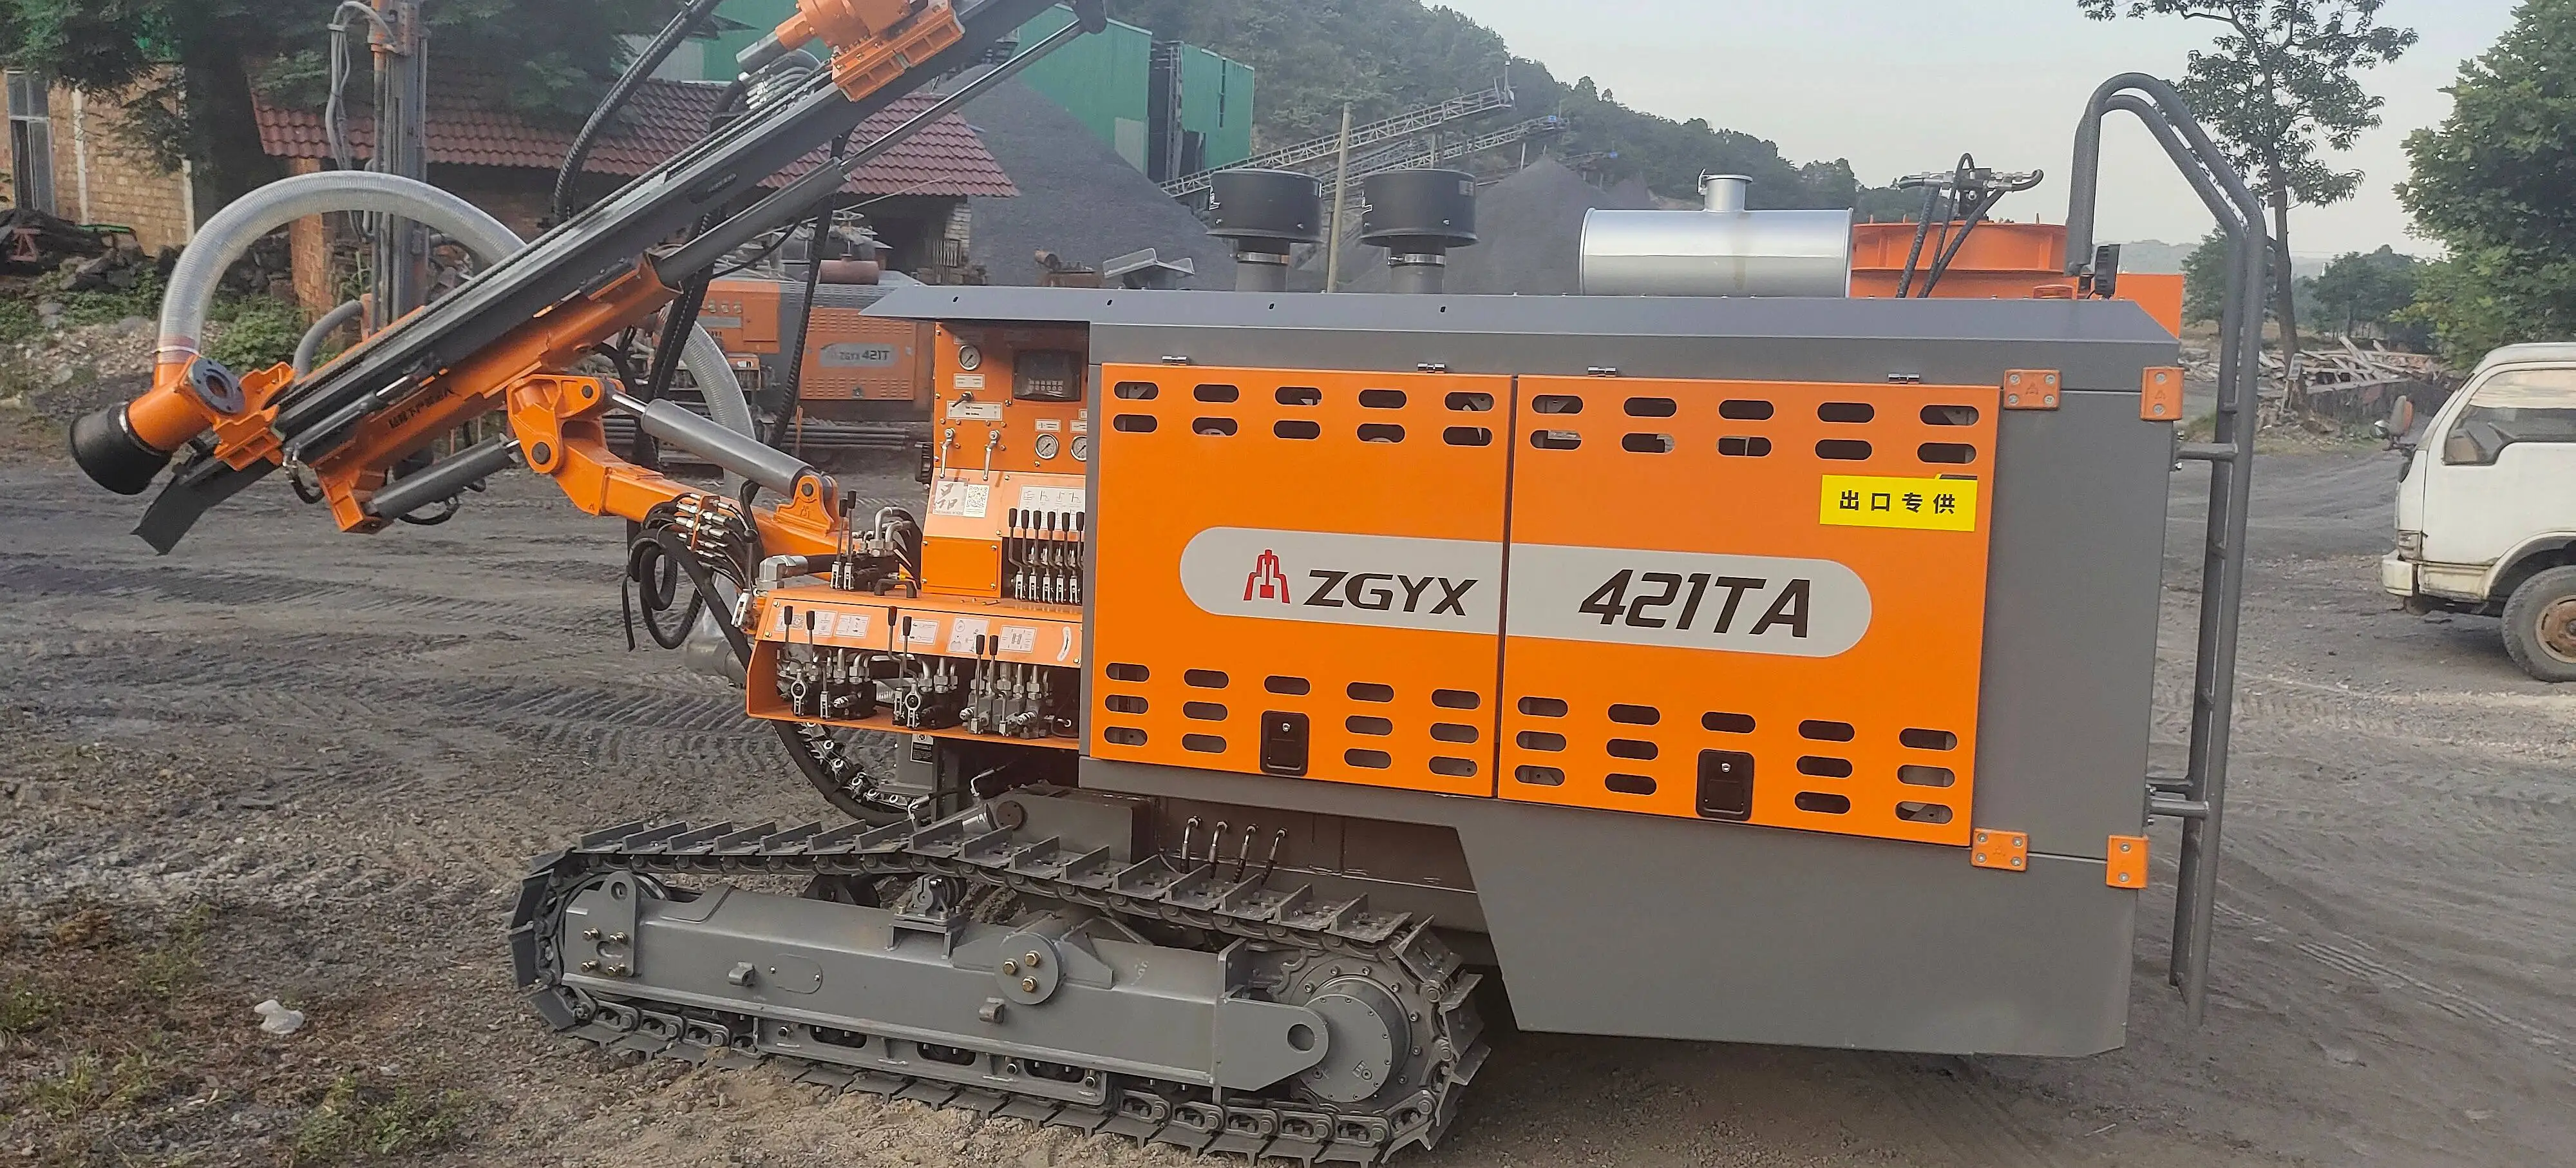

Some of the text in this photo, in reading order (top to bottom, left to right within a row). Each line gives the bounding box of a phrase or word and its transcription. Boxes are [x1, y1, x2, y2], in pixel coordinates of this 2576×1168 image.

[862, 350, 890, 360] 421T
[1839, 490, 1955, 514] 出口专供
[1303, 570, 1479, 616] ZGYX
[1578, 569, 1810, 638] 421TA
